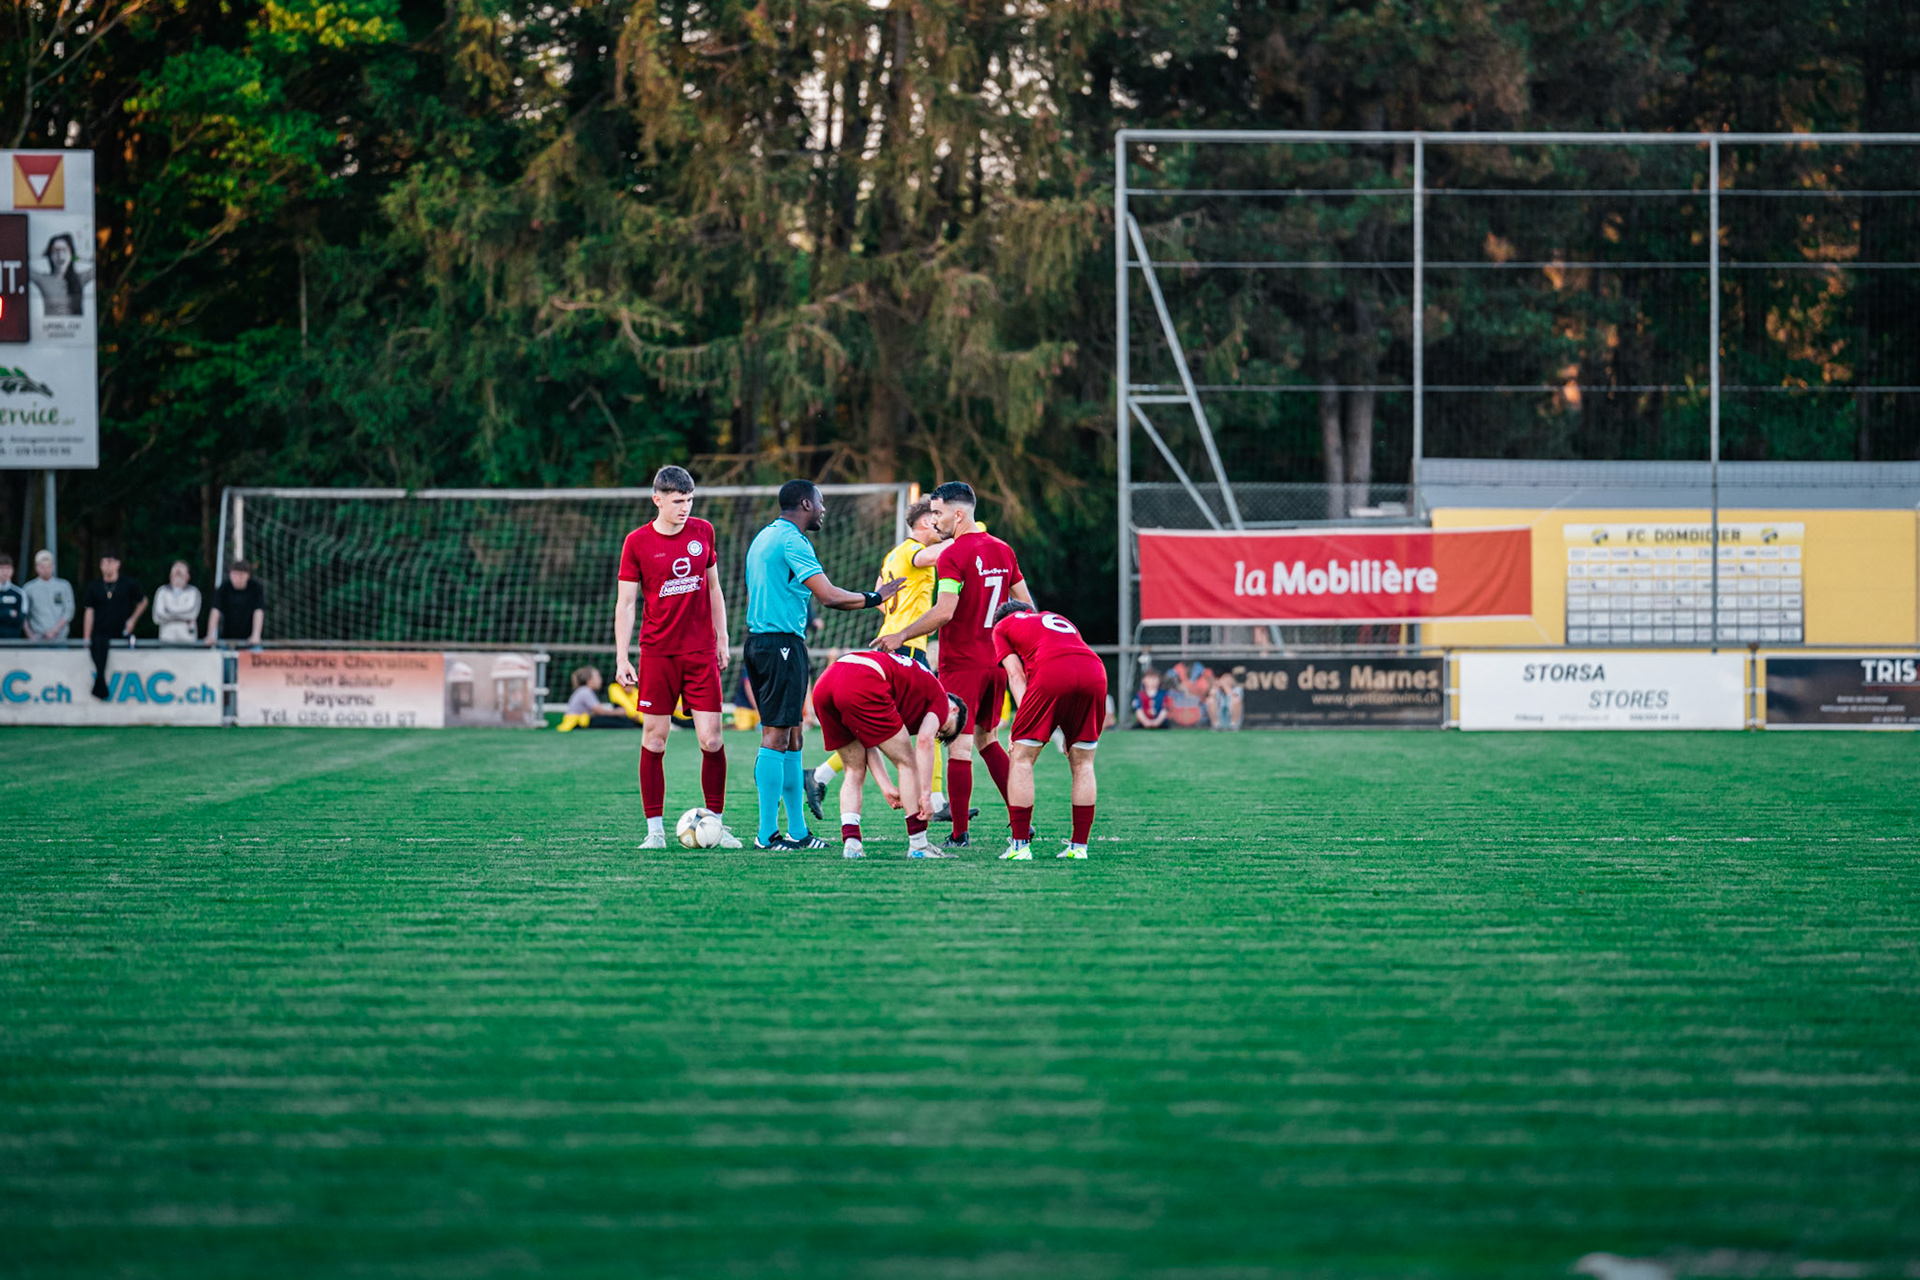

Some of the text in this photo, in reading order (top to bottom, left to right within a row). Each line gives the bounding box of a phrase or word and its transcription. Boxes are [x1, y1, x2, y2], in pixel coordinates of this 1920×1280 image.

[1626, 528, 1645, 543] FC
[1234, 559, 1438, 595] la Mobilière
[983, 576, 1003, 628] 7
[1041, 614, 1077, 634] 6
[1297, 664, 1340, 691] des
[1350, 665, 1439, 691] Marnes
[1522, 663, 1606, 682] STORSA
[0, 670, 72, 704] C.ch
[303, 690, 376, 708] Payerne
[1588, 690, 1670, 709] STORES
